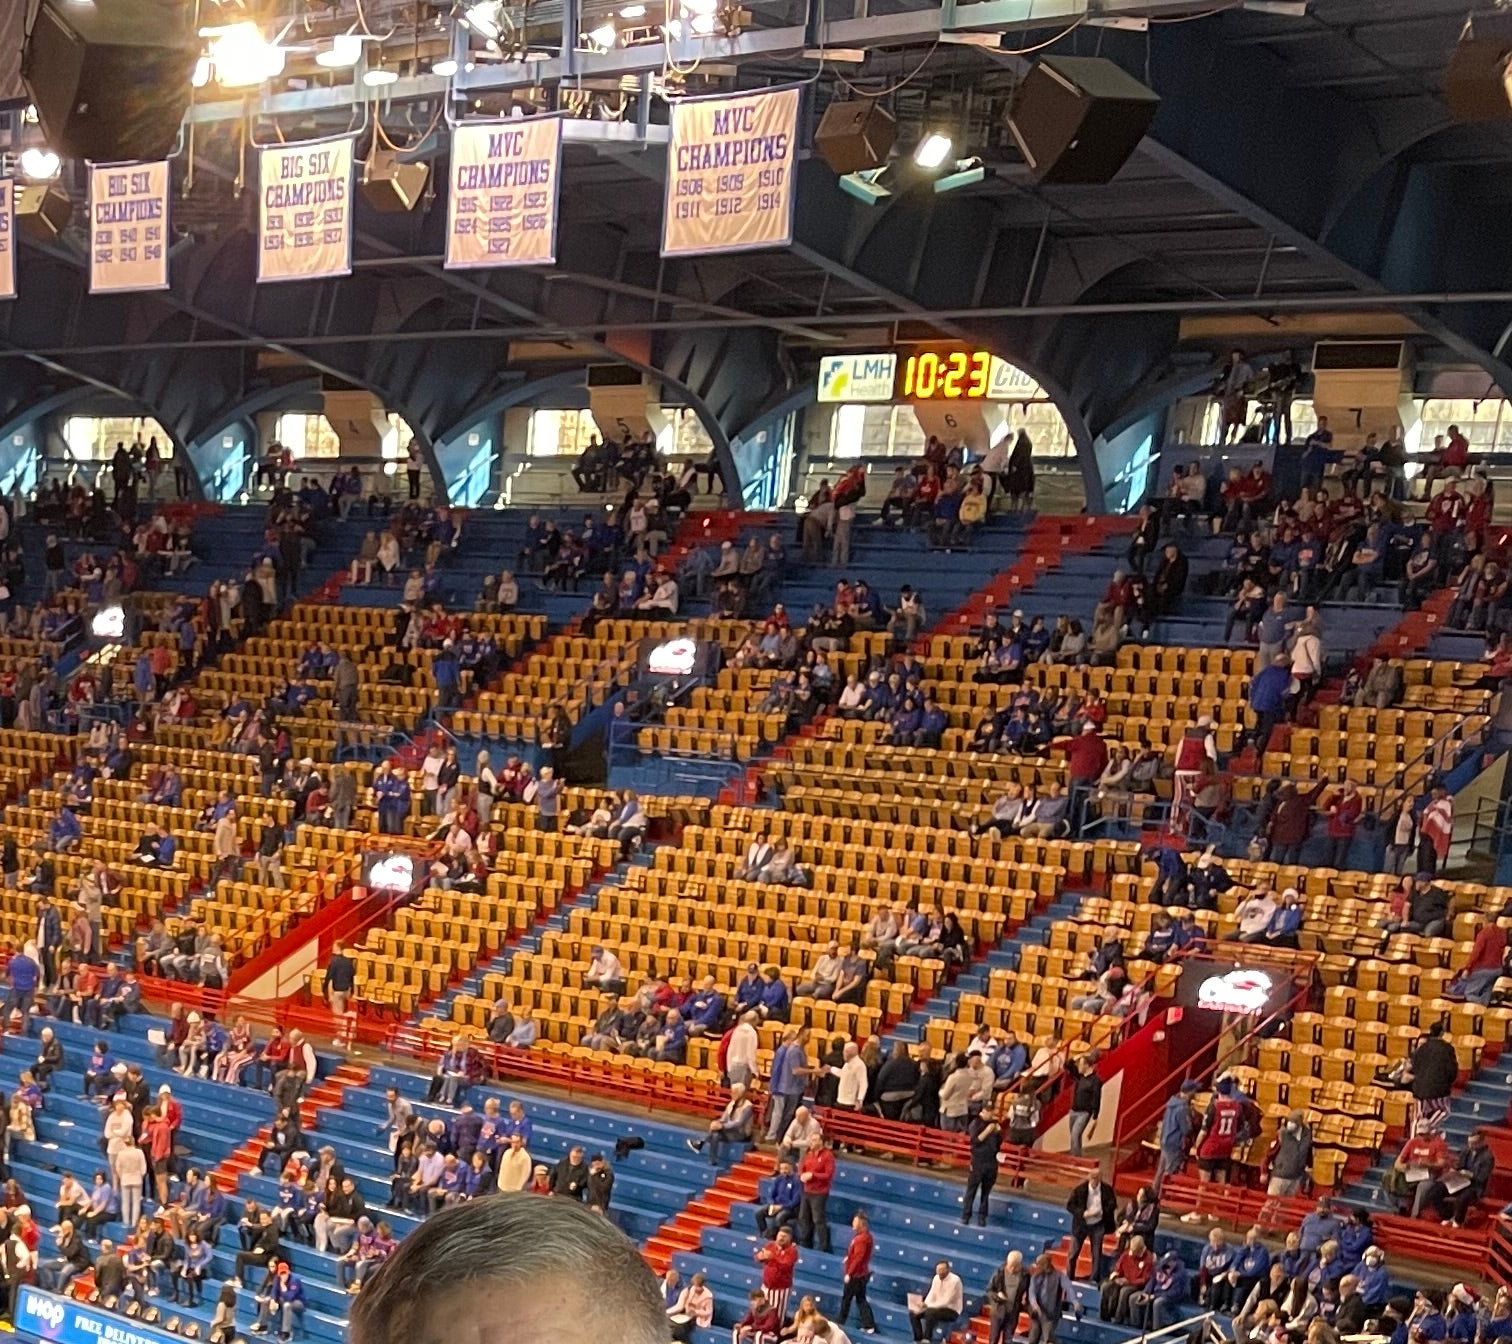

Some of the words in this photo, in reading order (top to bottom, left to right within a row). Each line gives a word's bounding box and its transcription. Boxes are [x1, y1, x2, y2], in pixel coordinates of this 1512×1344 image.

[713, 106, 756, 137] MVC
[488, 131, 524, 159] MVC
[676, 133, 788, 172] CHAMPIONS
[280, 154, 304, 180] BIG
[308, 150, 330, 174] SIX
[457, 159, 550, 191] CHAMPIONS
[108, 173, 127, 197] BIG
[130, 171, 151, 195] SIX
[265, 176, 345, 210] CHAMPIONS
[675, 178, 704, 197] 1908
[757, 169, 785, 188] 1910
[95, 197, 163, 224] CHAMPIONS
[674, 201, 701, 220] 1911
[714, 196, 742, 216] 1912
[756, 191, 782, 212] 1914
[852, 358, 893, 380] LMH
[904, 352, 990, 399] 10:23
[851, 380, 890, 397] Health
[944, 414, 958, 428] 6
[1349, 407, 1364, 431] 7
[1218, 1117, 1234, 1136] 11
[26, 1295, 65, 1329] IHOP
[74, 1315, 104, 1335] FREE
